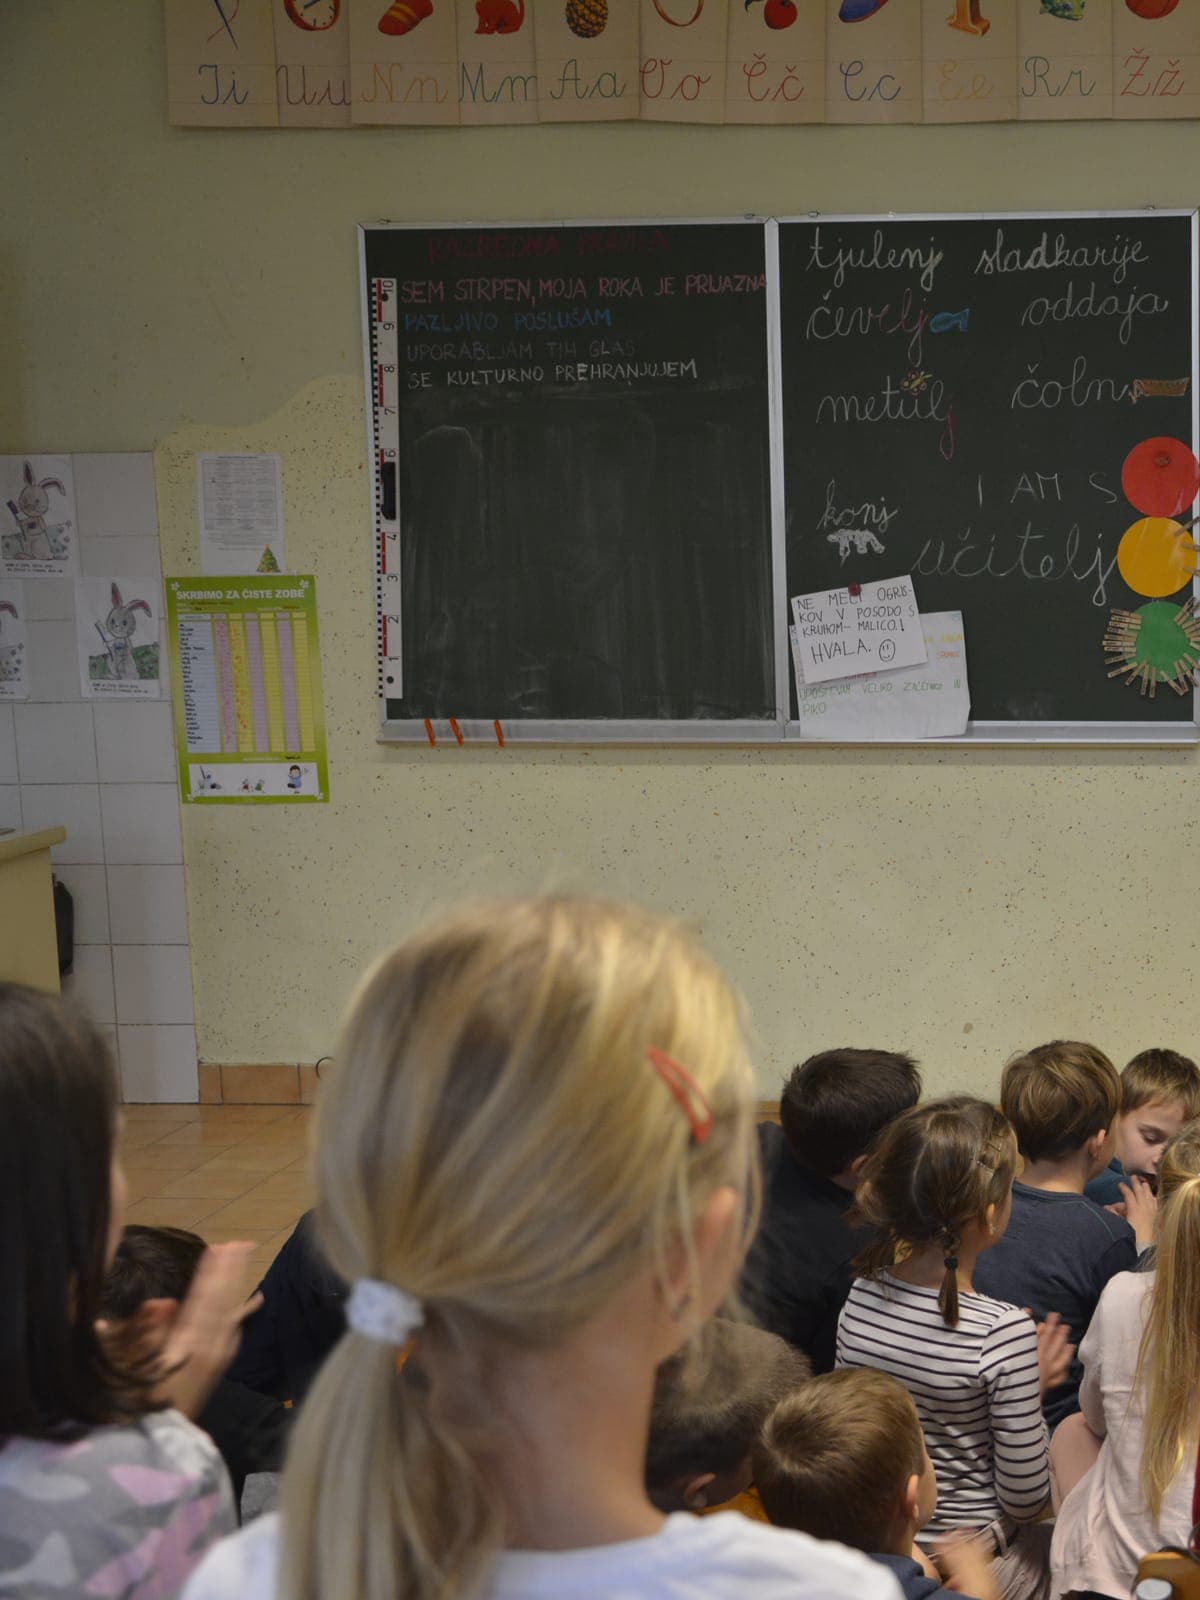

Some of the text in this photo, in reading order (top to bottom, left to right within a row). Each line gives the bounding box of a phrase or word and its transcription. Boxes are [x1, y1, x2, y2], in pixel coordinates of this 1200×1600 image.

[805, 226, 1150, 292] tjulenj sladkarije
[401, 278, 446, 305] SEM
[597, 276, 645, 298] ROKA
[655, 276, 676, 297] JE
[684, 273, 769, 297] PRIJAZNA
[404, 306, 613, 334] PAZLJIVO POSLUŠAM
[806, 281, 1169, 367] čevelj oddaja
[407, 342, 534, 363] UPORABLJAM
[590, 339, 637, 359] GLAS
[408, 358, 699, 390] SE KULTURNO PREHRANJUJEM
[816, 374, 958, 460] metulj
[1011, 471, 1063, 504] AM
[816, 478, 899, 531] konj
[910, 519, 1119, 607] učitelj
[176, 588, 305, 600] SKRBIMO ZA ČISTE ZOBE
[797, 599, 814, 610] NE
[799, 610, 823, 624] KOV
[836, 608, 845, 621] V
[857, 605, 902, 620] POSODO
